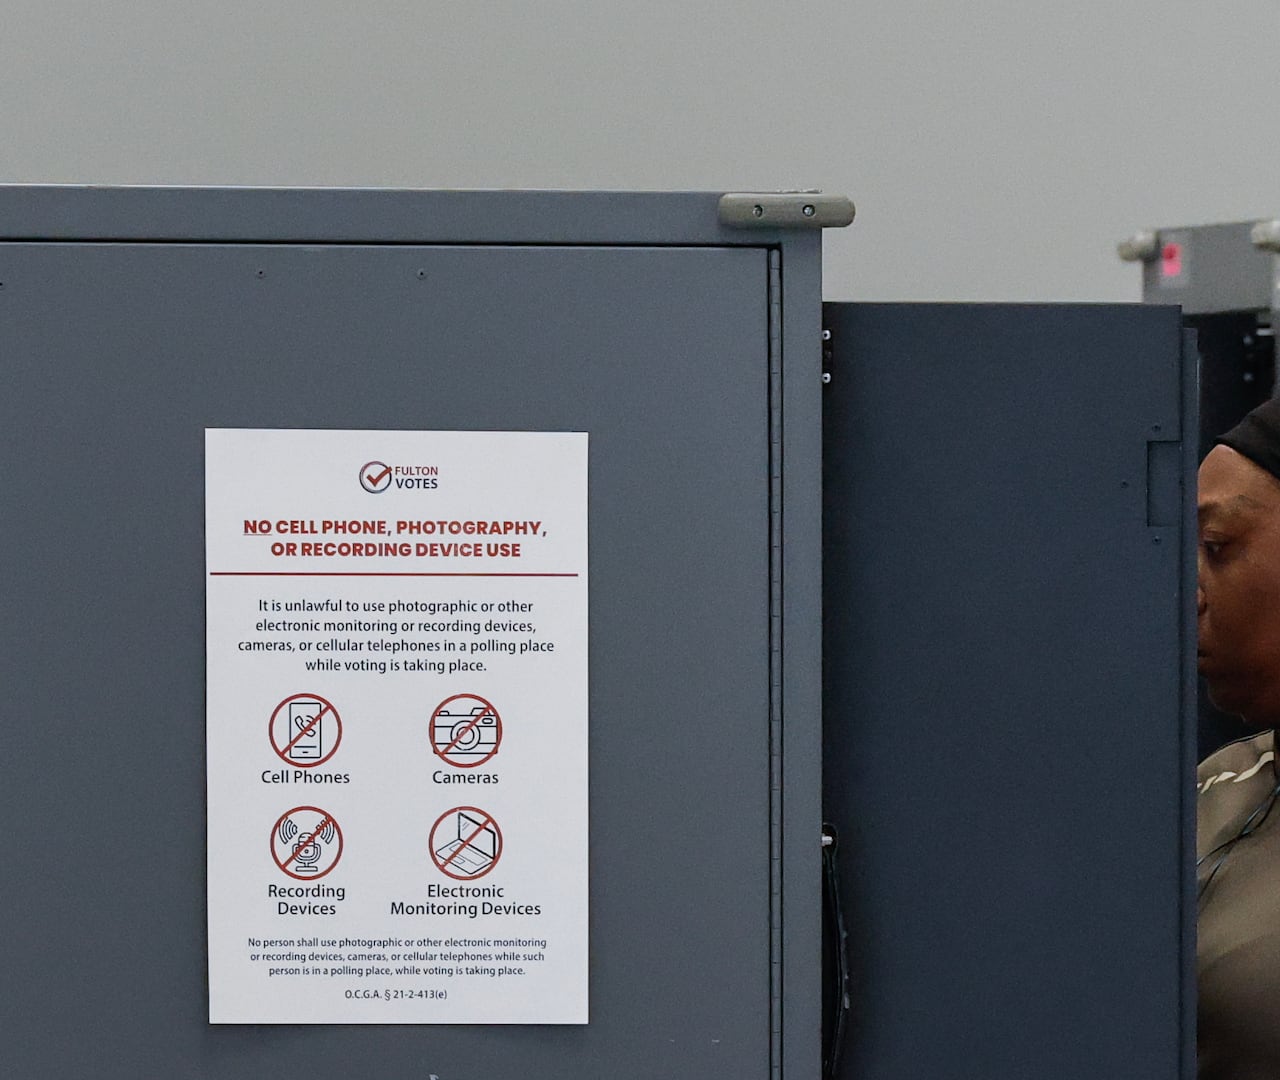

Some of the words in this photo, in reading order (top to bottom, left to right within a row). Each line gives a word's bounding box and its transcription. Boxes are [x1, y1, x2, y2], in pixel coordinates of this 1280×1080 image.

[395, 466, 438, 475] FULTON
[396, 479, 437, 489] VOTES
[244, 520, 272, 535] NO
[276, 520, 318, 534] CELL
[322, 520, 391, 536] PHONE,
[397, 521, 546, 537] PHOTOGRAPHY,
[271, 543, 297, 556] OR
[302, 543, 411, 556] RECORDING
[416, 543, 482, 556] DEVICE
[487, 543, 520, 557] USE
[260, 600, 268, 611] It
[272, 600, 281, 611] is
[285, 599, 341, 611] unlawful
[346, 601, 359, 611] to
[363, 603, 385, 611] use
[389, 600, 477, 614] photographic
[481, 603, 494, 612] or
[498, 600, 533, 612] other
[256, 619, 320, 631] electronic
[324, 620, 397, 633] monitoring
[402, 623, 414, 631] or
[419, 620, 480, 633] recording
[485, 620, 535, 633] devices,
[238, 642, 295, 652] cameras,
[299, 642, 312, 651] or
[316, 639, 364, 651] cellular
[368, 639, 440, 654] telephones
[444, 640, 455, 651] in
[460, 643, 466, 651] a
[471, 640, 515, 654] polling
[520, 639, 554, 654] place
[306, 658, 341, 670] while
[345, 659, 386, 674] voting
[391, 659, 399, 671] is
[404, 659, 444, 674] taking
[449, 659, 486, 674] place.
[262, 770, 288, 783] Cell
[294, 770, 350, 783] Phones
[433, 771, 498, 784] Cameras
[269, 884, 345, 900] Recording
[428, 884, 504, 897] Electronic
[278, 902, 336, 915] Devices
[391, 902, 477, 918] Monitoring
[482, 902, 541, 915] Devices
[249, 938, 261, 947] No
[264, 940, 294, 949] person
[297, 938, 318, 947] shall
[339, 938, 402, 949] photographic
[417, 938, 442, 947] other
[445, 938, 491, 947] electronic
[494, 939, 546, 949] monitoring
[262, 952, 307, 963] recording
[309, 952, 346, 961] devices,
[403, 952, 438, 961] cellular
[440, 952, 493, 963] telephones
[495, 952, 521, 961] while
[523, 952, 545, 961] such
[269, 968, 300, 976] person
[303, 967, 309, 975] is
[331, 966, 363, 977] polling
[366, 966, 392, 976] place,
[395, 966, 421, 975] while
[423, 966, 453, 977] voting
[456, 967, 463, 975] is
[466, 966, 495, 977] taking
[498, 966, 525, 976] place.
[345, 990, 382, 999] O.C.G.A.
[385, 989, 391, 1001] §
[394, 990, 447, 999] 21-2-413(e)
